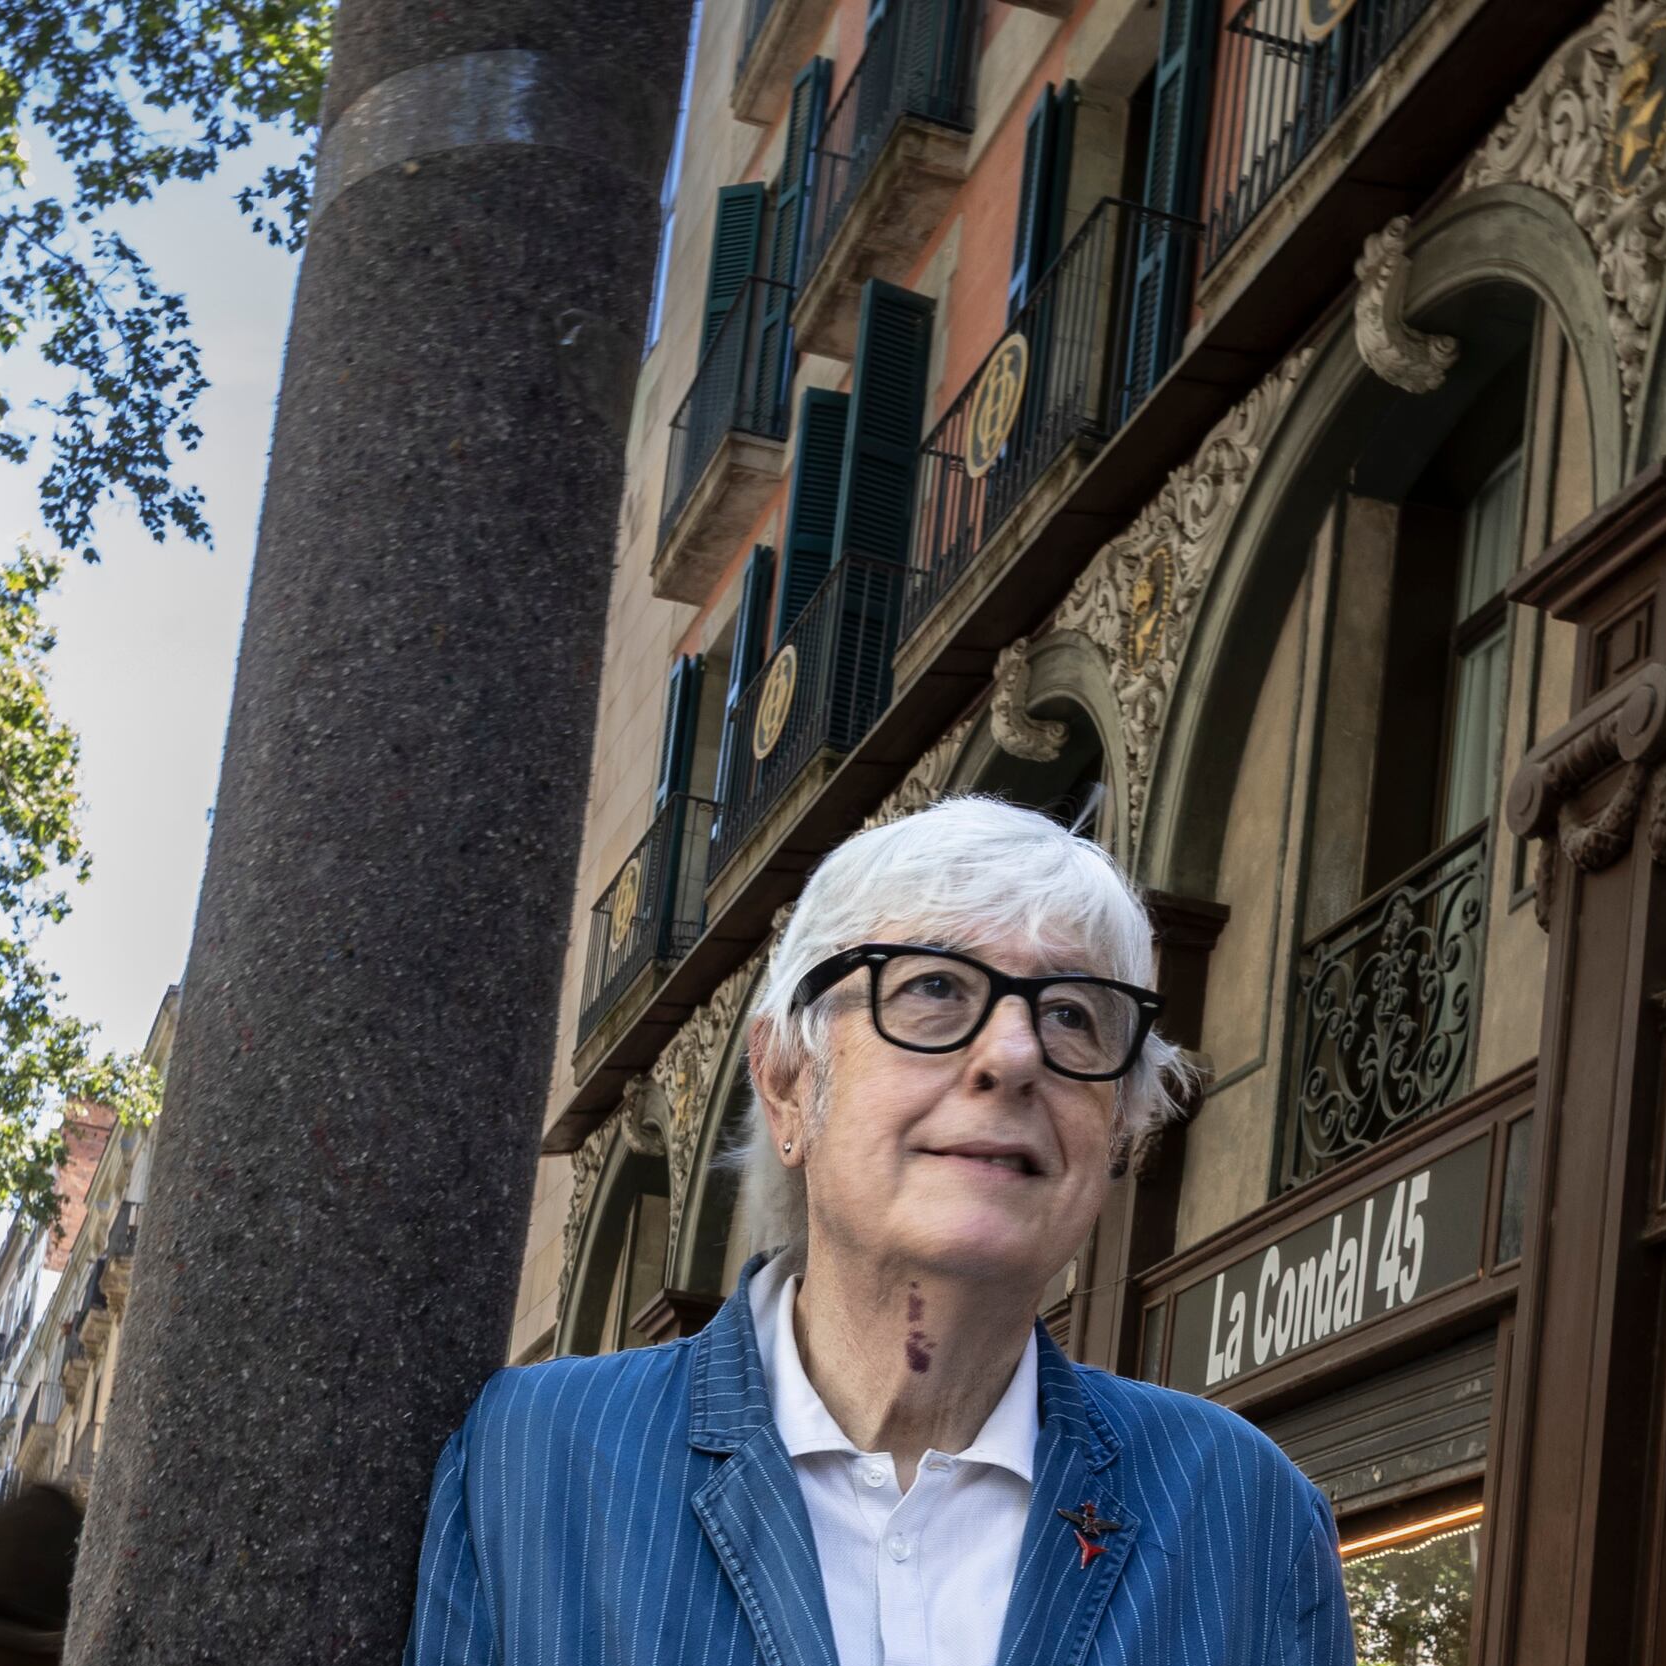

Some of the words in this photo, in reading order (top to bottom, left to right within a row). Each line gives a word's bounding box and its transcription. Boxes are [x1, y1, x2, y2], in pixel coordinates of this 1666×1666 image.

[1206, 1273, 1246, 1386] La
[1253, 1198, 1374, 1366] Condal
[1376, 1170, 1430, 1309] 45
